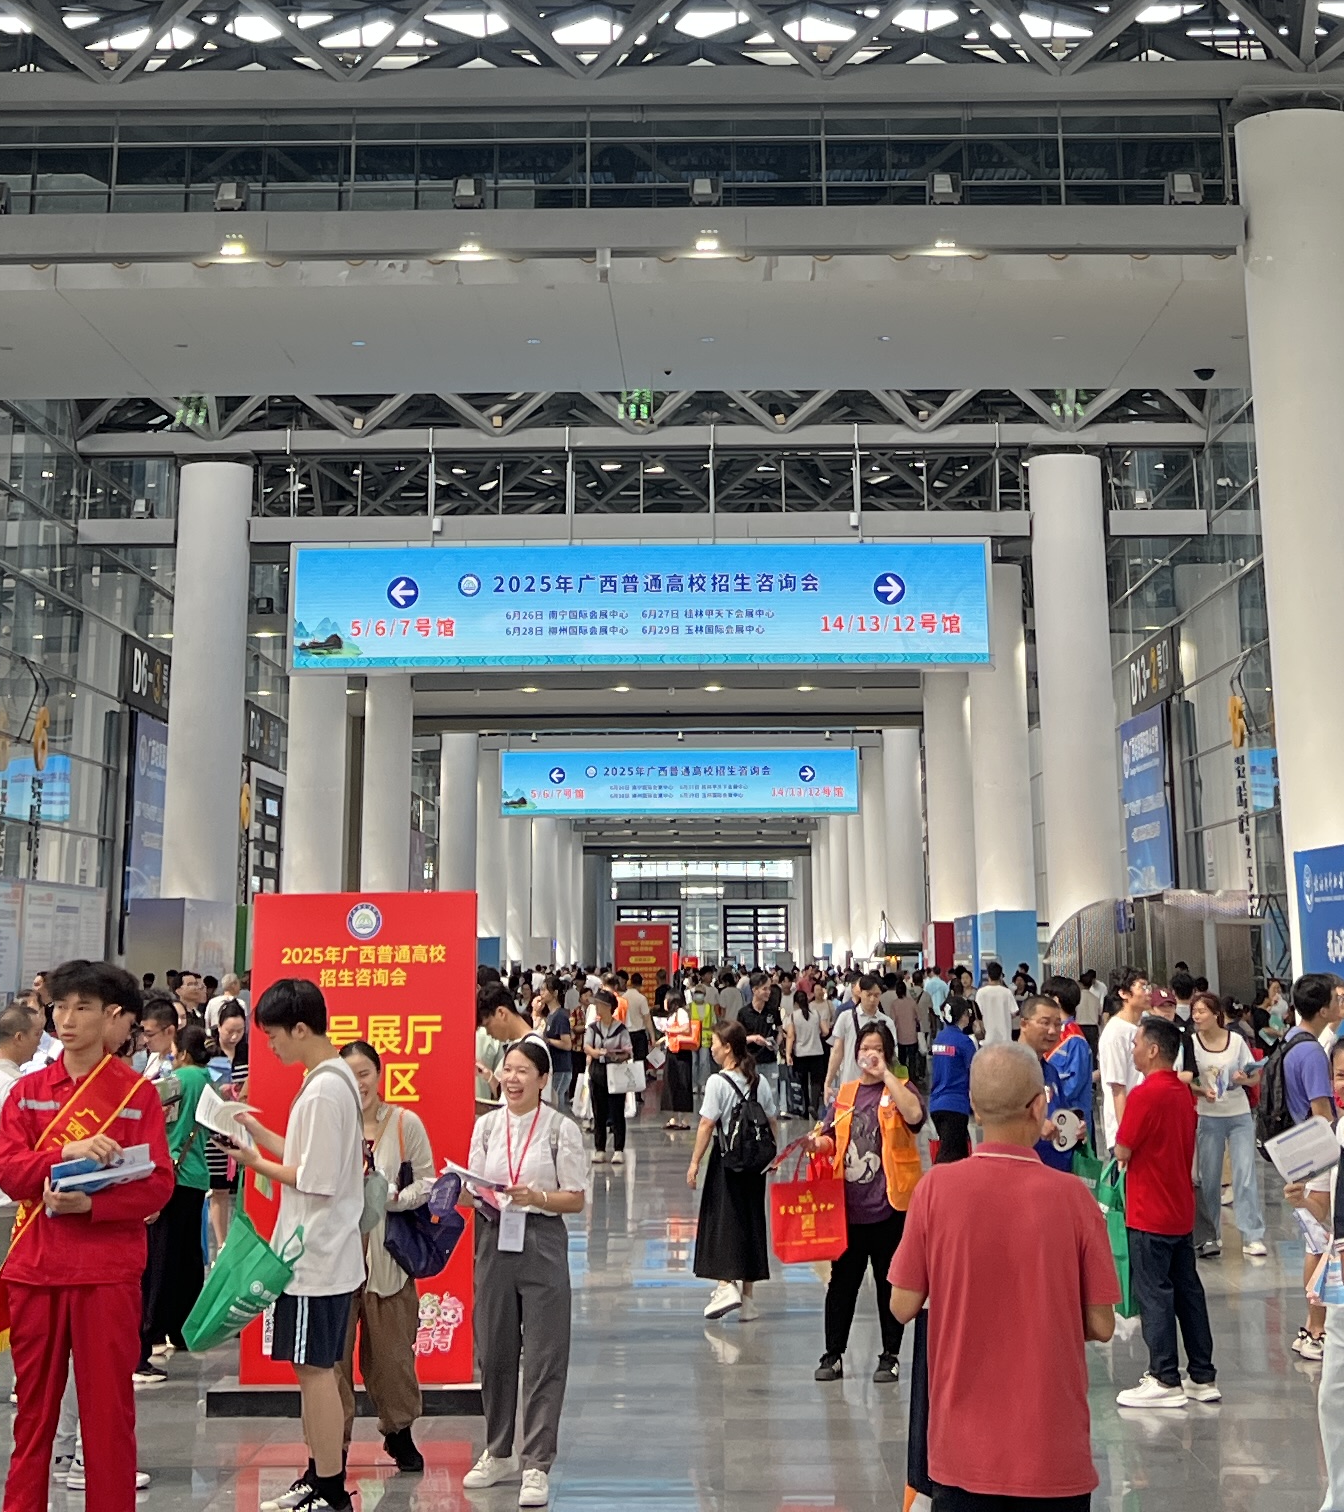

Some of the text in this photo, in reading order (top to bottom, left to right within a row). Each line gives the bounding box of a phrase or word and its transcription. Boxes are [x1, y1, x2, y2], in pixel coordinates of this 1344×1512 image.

[493, 573, 820, 594] 2025年广西普通高校招生咨询会
[506, 609, 544, 621] 6月26日
[548, 609, 629, 620] 南宁国际会展中心
[641, 608, 679, 619] 6月27日
[350, 613, 961, 638] 5/6/7号馆 6月28日 柳州国际会展中心 6月29日 玉林国际会展中心 14/13/12号馆
[603, 765, 772, 777] 2025年广西普通高校招生咨询会
[281, 944, 447, 965] 2025年广西普通高校
[319, 967, 407, 987] 招生咨询会
[414, 1326, 453, 1354] 高考
